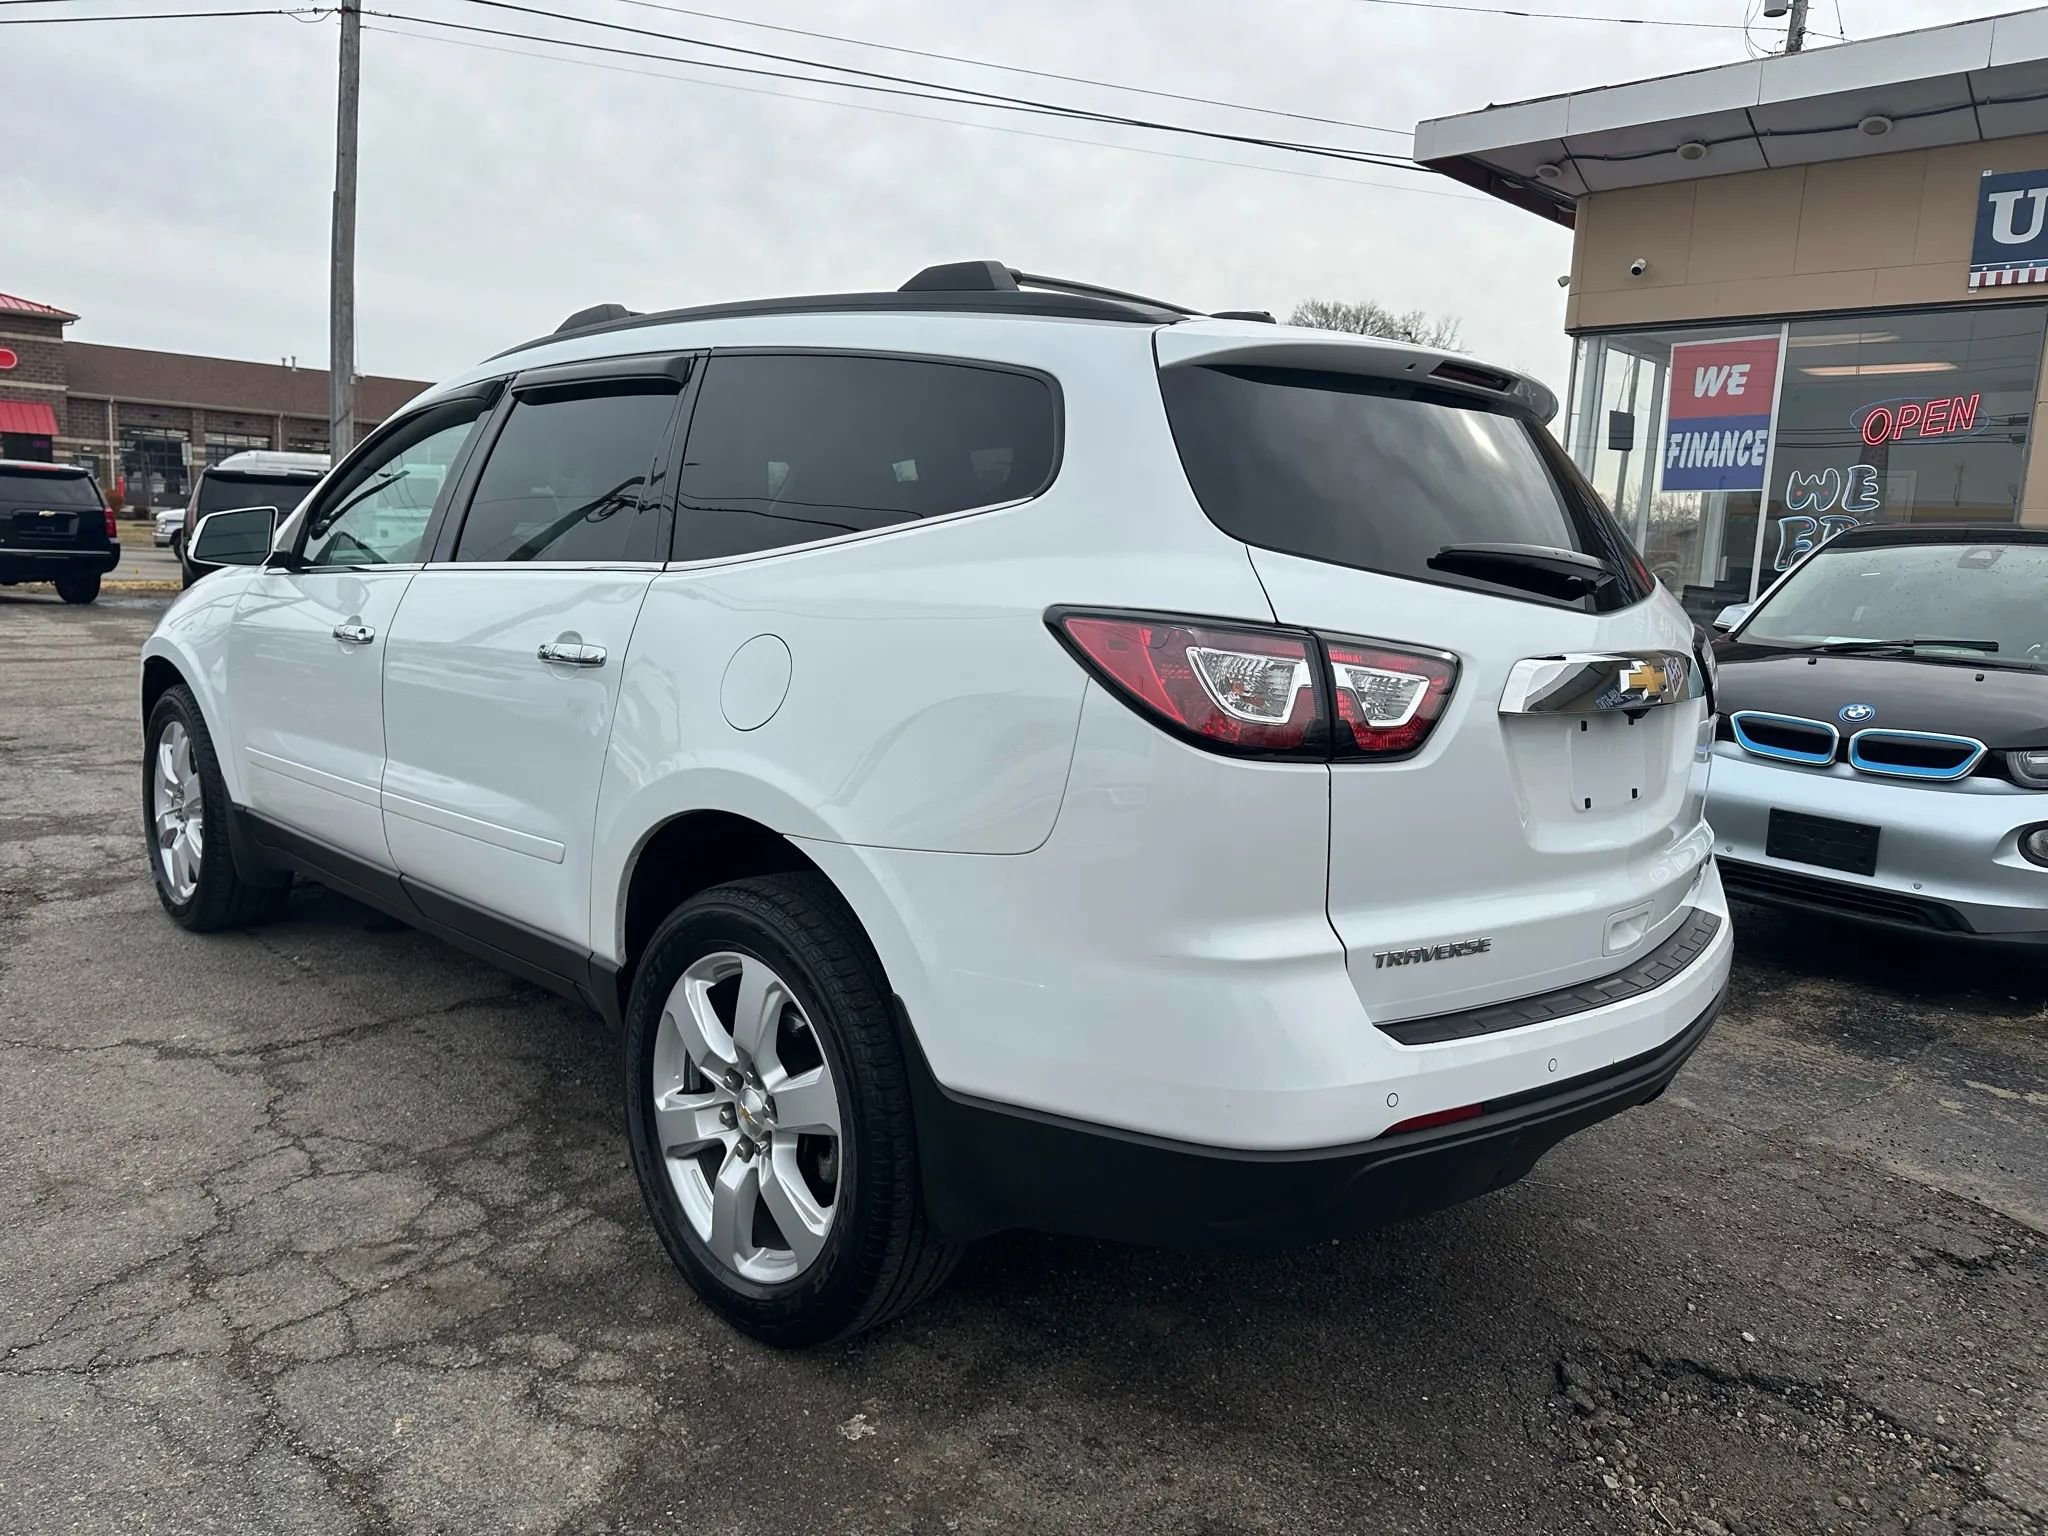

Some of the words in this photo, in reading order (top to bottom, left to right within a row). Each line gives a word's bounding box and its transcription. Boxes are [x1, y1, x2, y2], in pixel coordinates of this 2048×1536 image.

[1694, 363, 1751, 399] WE
[1862, 393, 1979, 447] OPEN
[1666, 429, 1768, 470] FINANCE
[1786, 465, 1880, 512] WE
[1374, 937, 1493, 968] TRAVERSE
